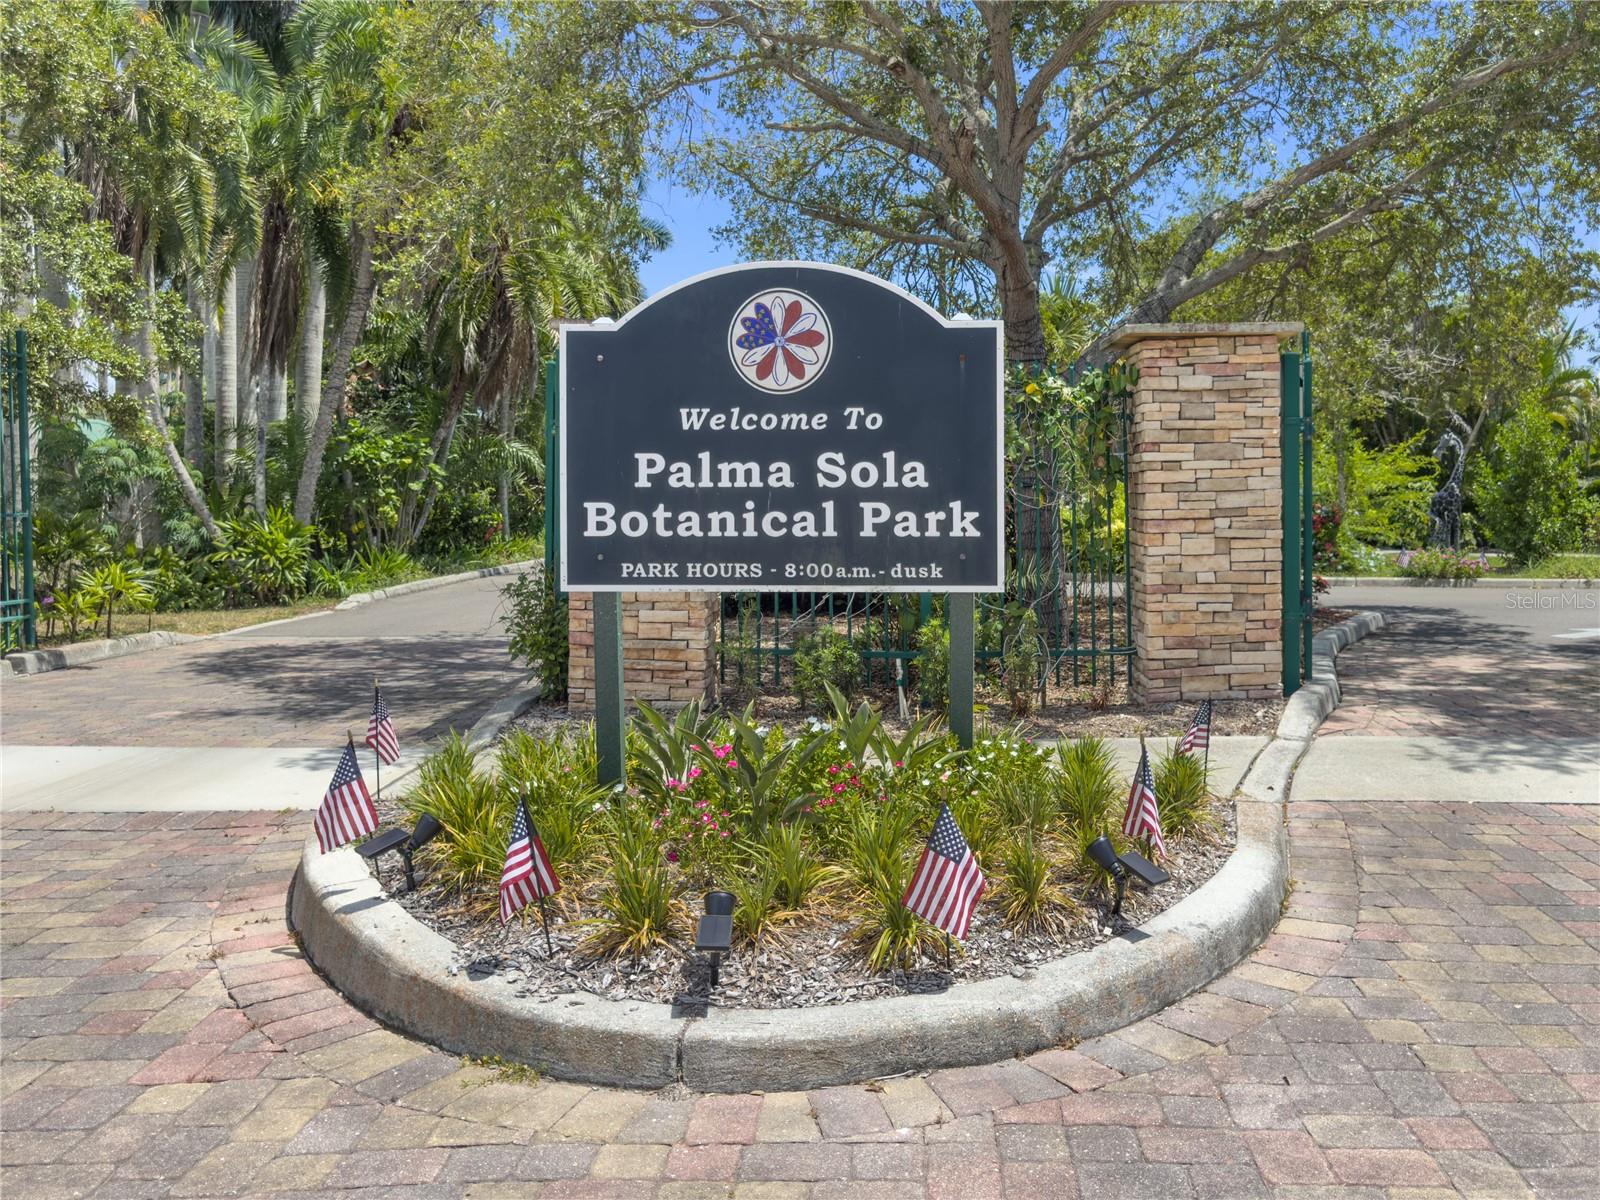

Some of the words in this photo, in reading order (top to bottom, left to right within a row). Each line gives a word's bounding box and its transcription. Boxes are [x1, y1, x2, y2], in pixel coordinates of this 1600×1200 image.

[679, 407, 827, 430] Welcome
[843, 407, 882, 430] To
[633, 450, 794, 488] Palma
[816, 450, 929, 488] Sola
[583, 500, 837, 537] Botanical
[859, 501, 980, 537] Park
[621, 562, 678, 577] PARK
[686, 562, 763, 577] HOURS
[890, 562, 943, 577] dusk
